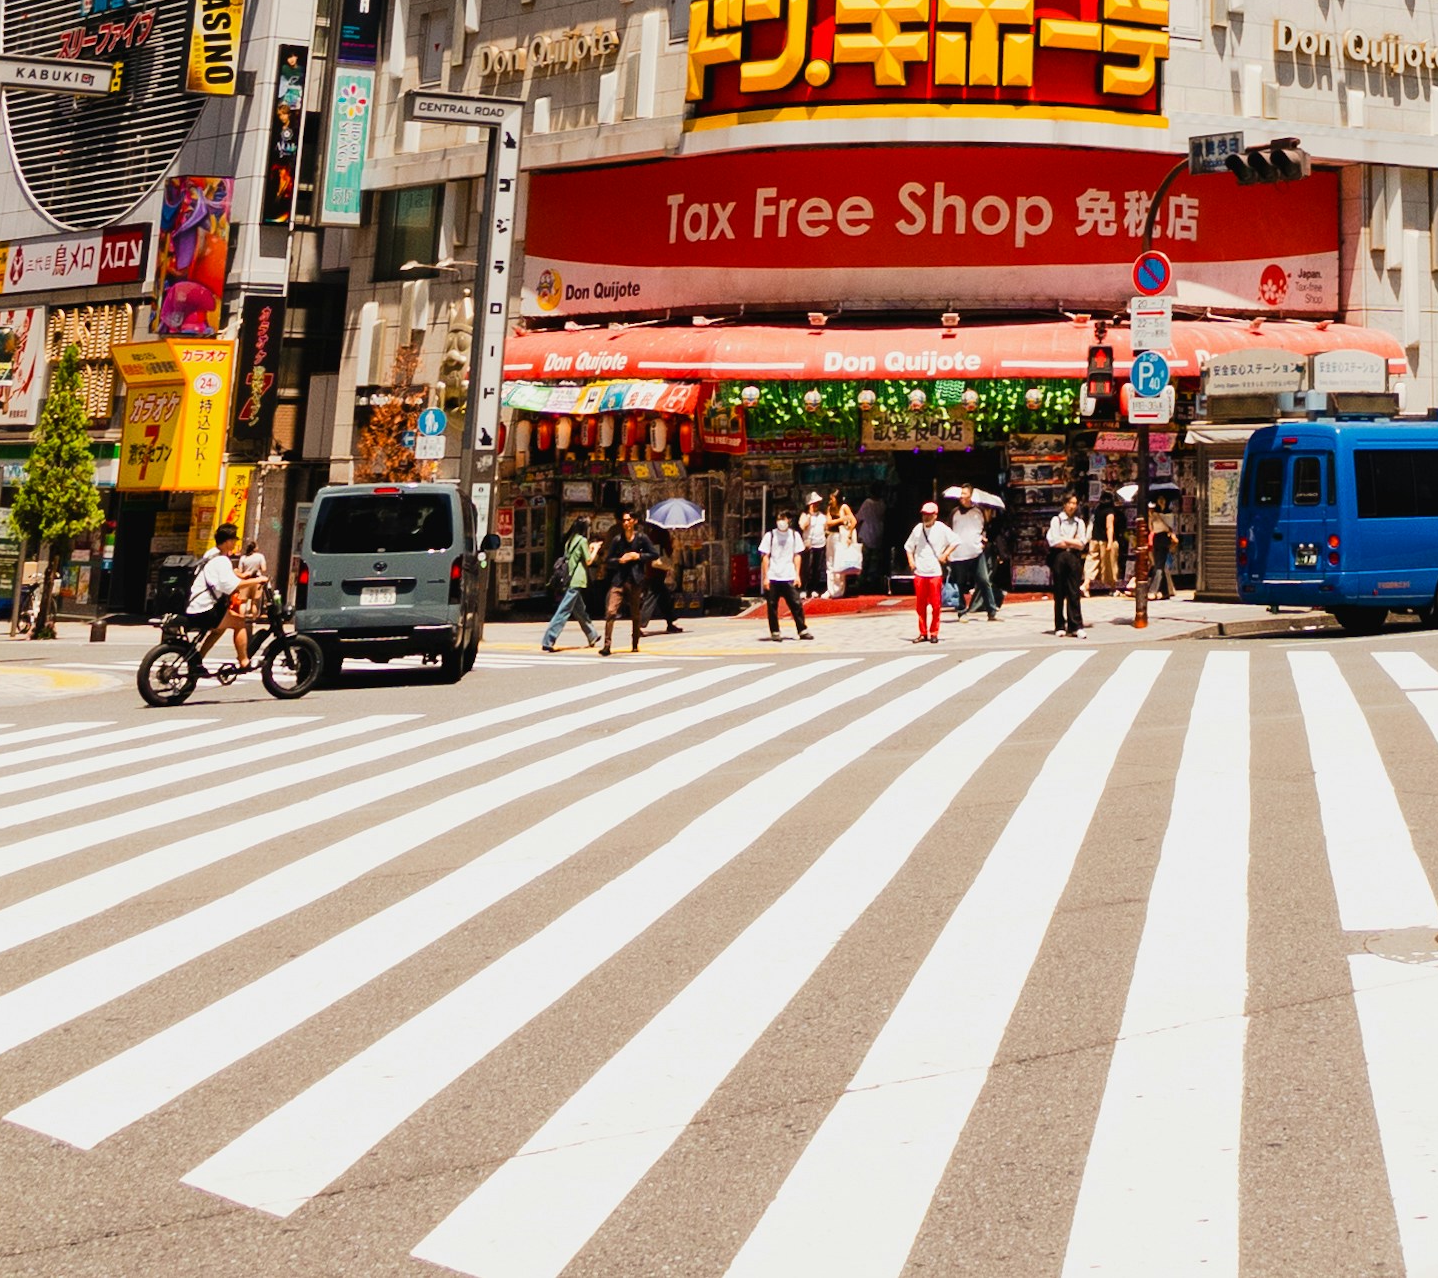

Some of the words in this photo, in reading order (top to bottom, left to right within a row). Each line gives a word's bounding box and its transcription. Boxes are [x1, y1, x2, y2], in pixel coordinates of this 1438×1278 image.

[1274, 19, 1332, 59] Don
[477, 46, 525, 78] Don
[527, 28, 620, 70] Quijote
[418, 100, 470, 118] CENTRAL
[473, 104, 506, 120] ROAD
[666, 192, 737, 245] Tax
[753, 187, 875, 239] Free
[894, 180, 1055, 248] Shop
[1073, 187, 1202, 244] 免税店
[25, 254, 53, 274] 三代目
[53, 243, 96, 277] 鳥メロ
[1296, 267, 1324, 281] Japan.
[481, 176, 516, 402] ゴジラロード
[564, 279, 590, 302] Don
[592, 276, 642, 301] Quijote
[181, 348, 228, 362] カラオケ
[542, 351, 572, 374] Don
[574, 350, 629, 372] Quijote
[822, 350, 879, 374] Don
[886, 349, 983, 378] Quijote
[1212, 361, 1299, 379] 安全安心ステーション
[129, 392, 180, 425] カラオケ
